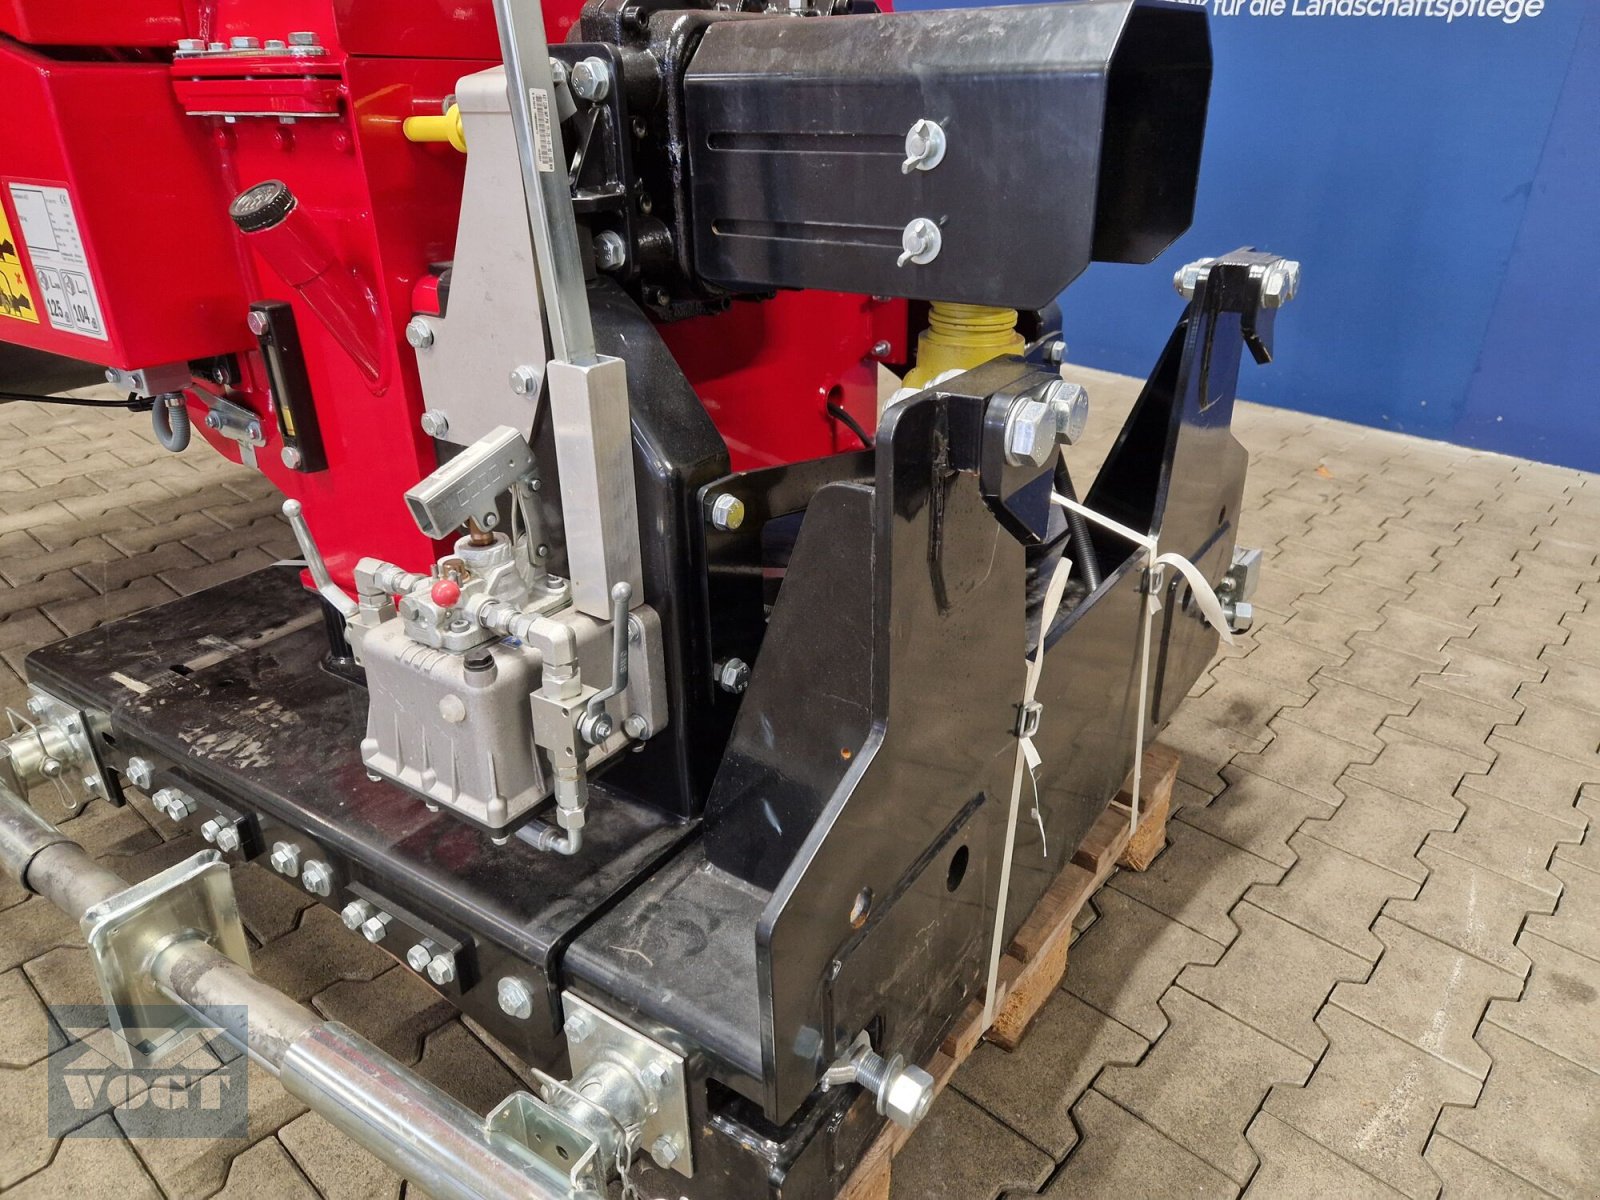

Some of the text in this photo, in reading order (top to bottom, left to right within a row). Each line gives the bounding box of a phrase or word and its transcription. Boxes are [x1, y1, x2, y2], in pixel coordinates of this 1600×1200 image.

[1249, 0, 1287, 16] die
[1291, 0, 1545, 24] Landschaftspflege
[47, 298, 64, 318] 125
[73, 304, 91, 324] 104
